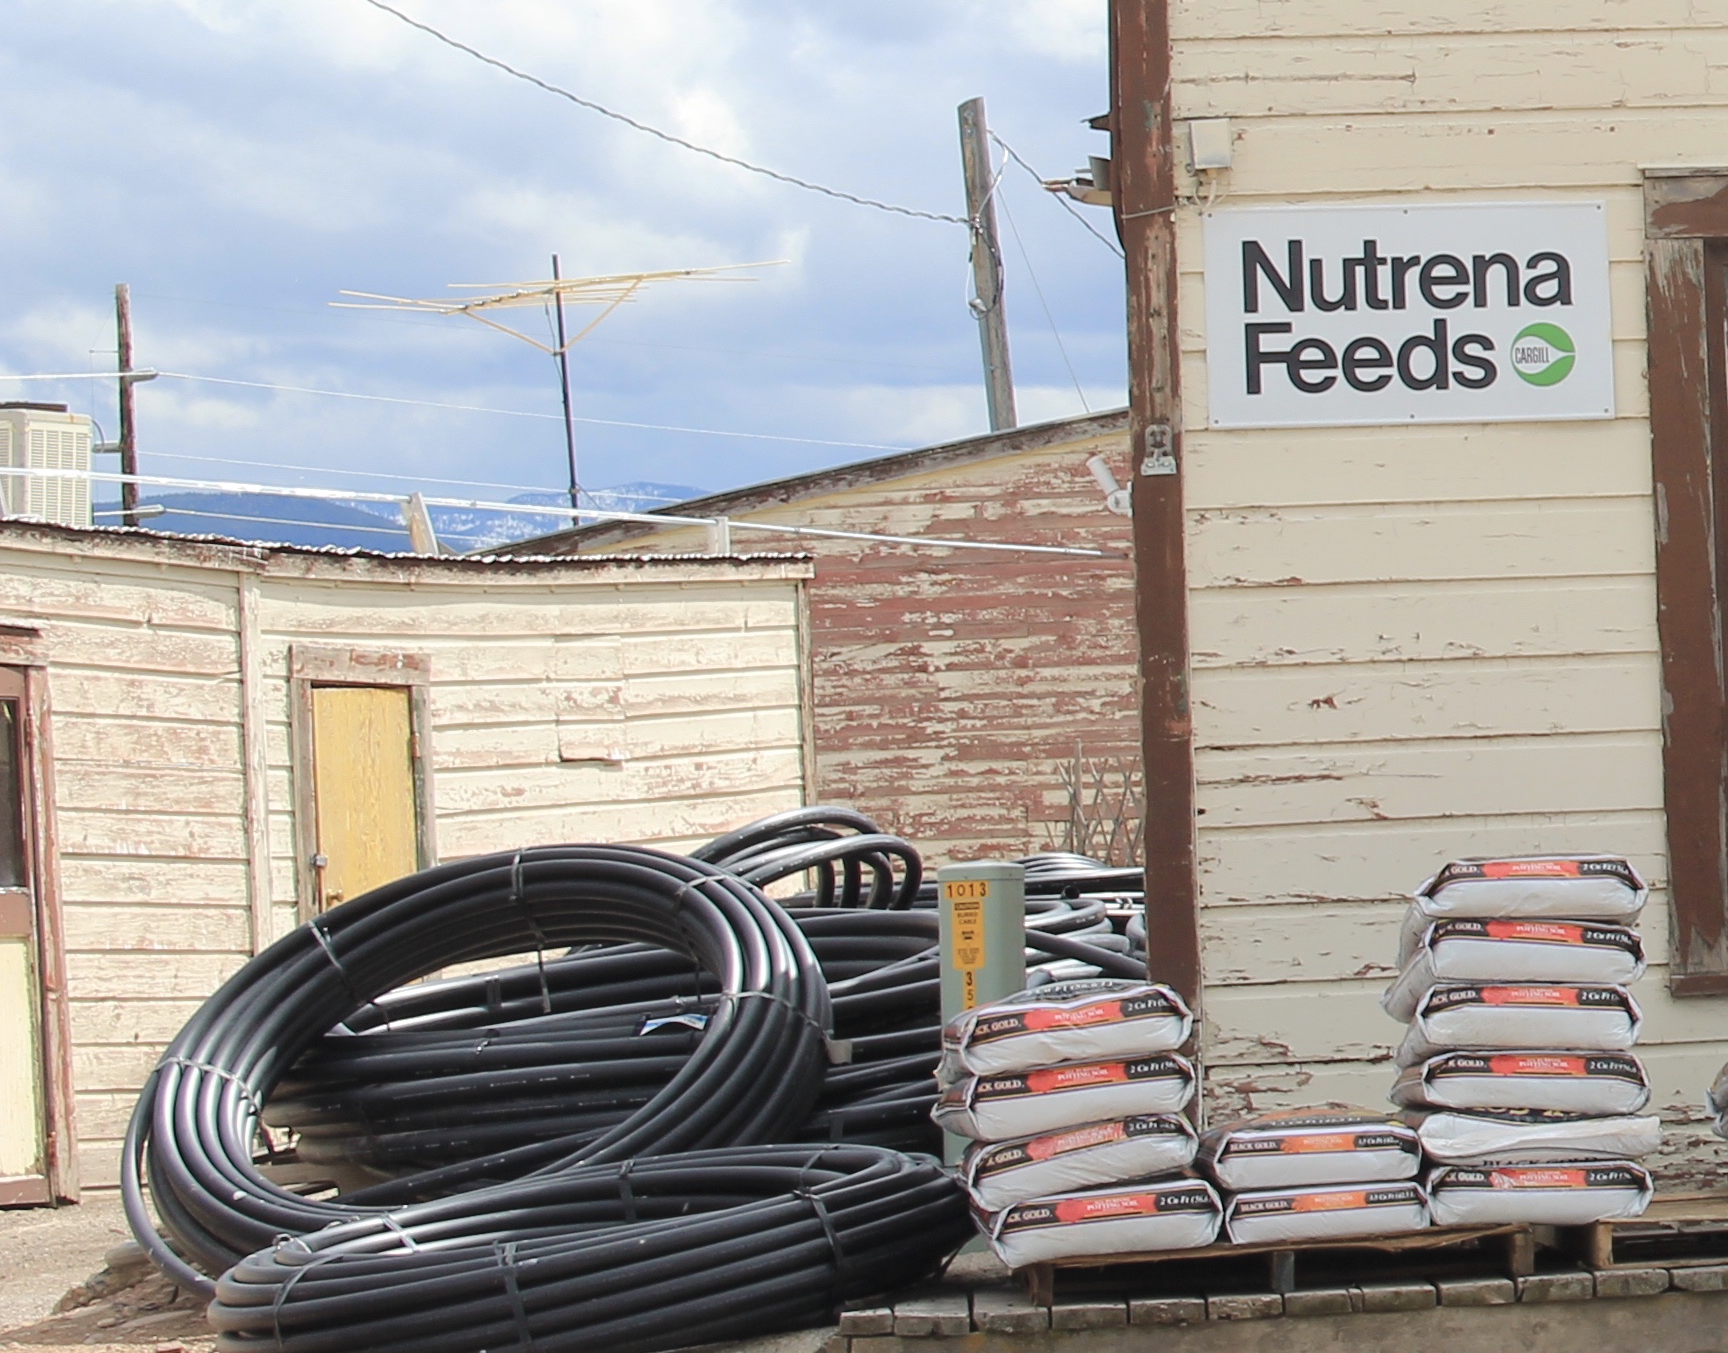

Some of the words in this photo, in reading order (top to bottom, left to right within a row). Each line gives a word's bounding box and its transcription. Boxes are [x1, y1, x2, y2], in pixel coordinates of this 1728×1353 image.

[1241, 238, 1573, 314] Nutrena
[1245, 318, 1498, 396] Feeds
[1514, 346, 1550, 364] CARGILL
[947, 882, 987, 898] 1013
[1130, 1065, 1136, 1073] 2
[1160, 1197, 1166, 1206] 2
